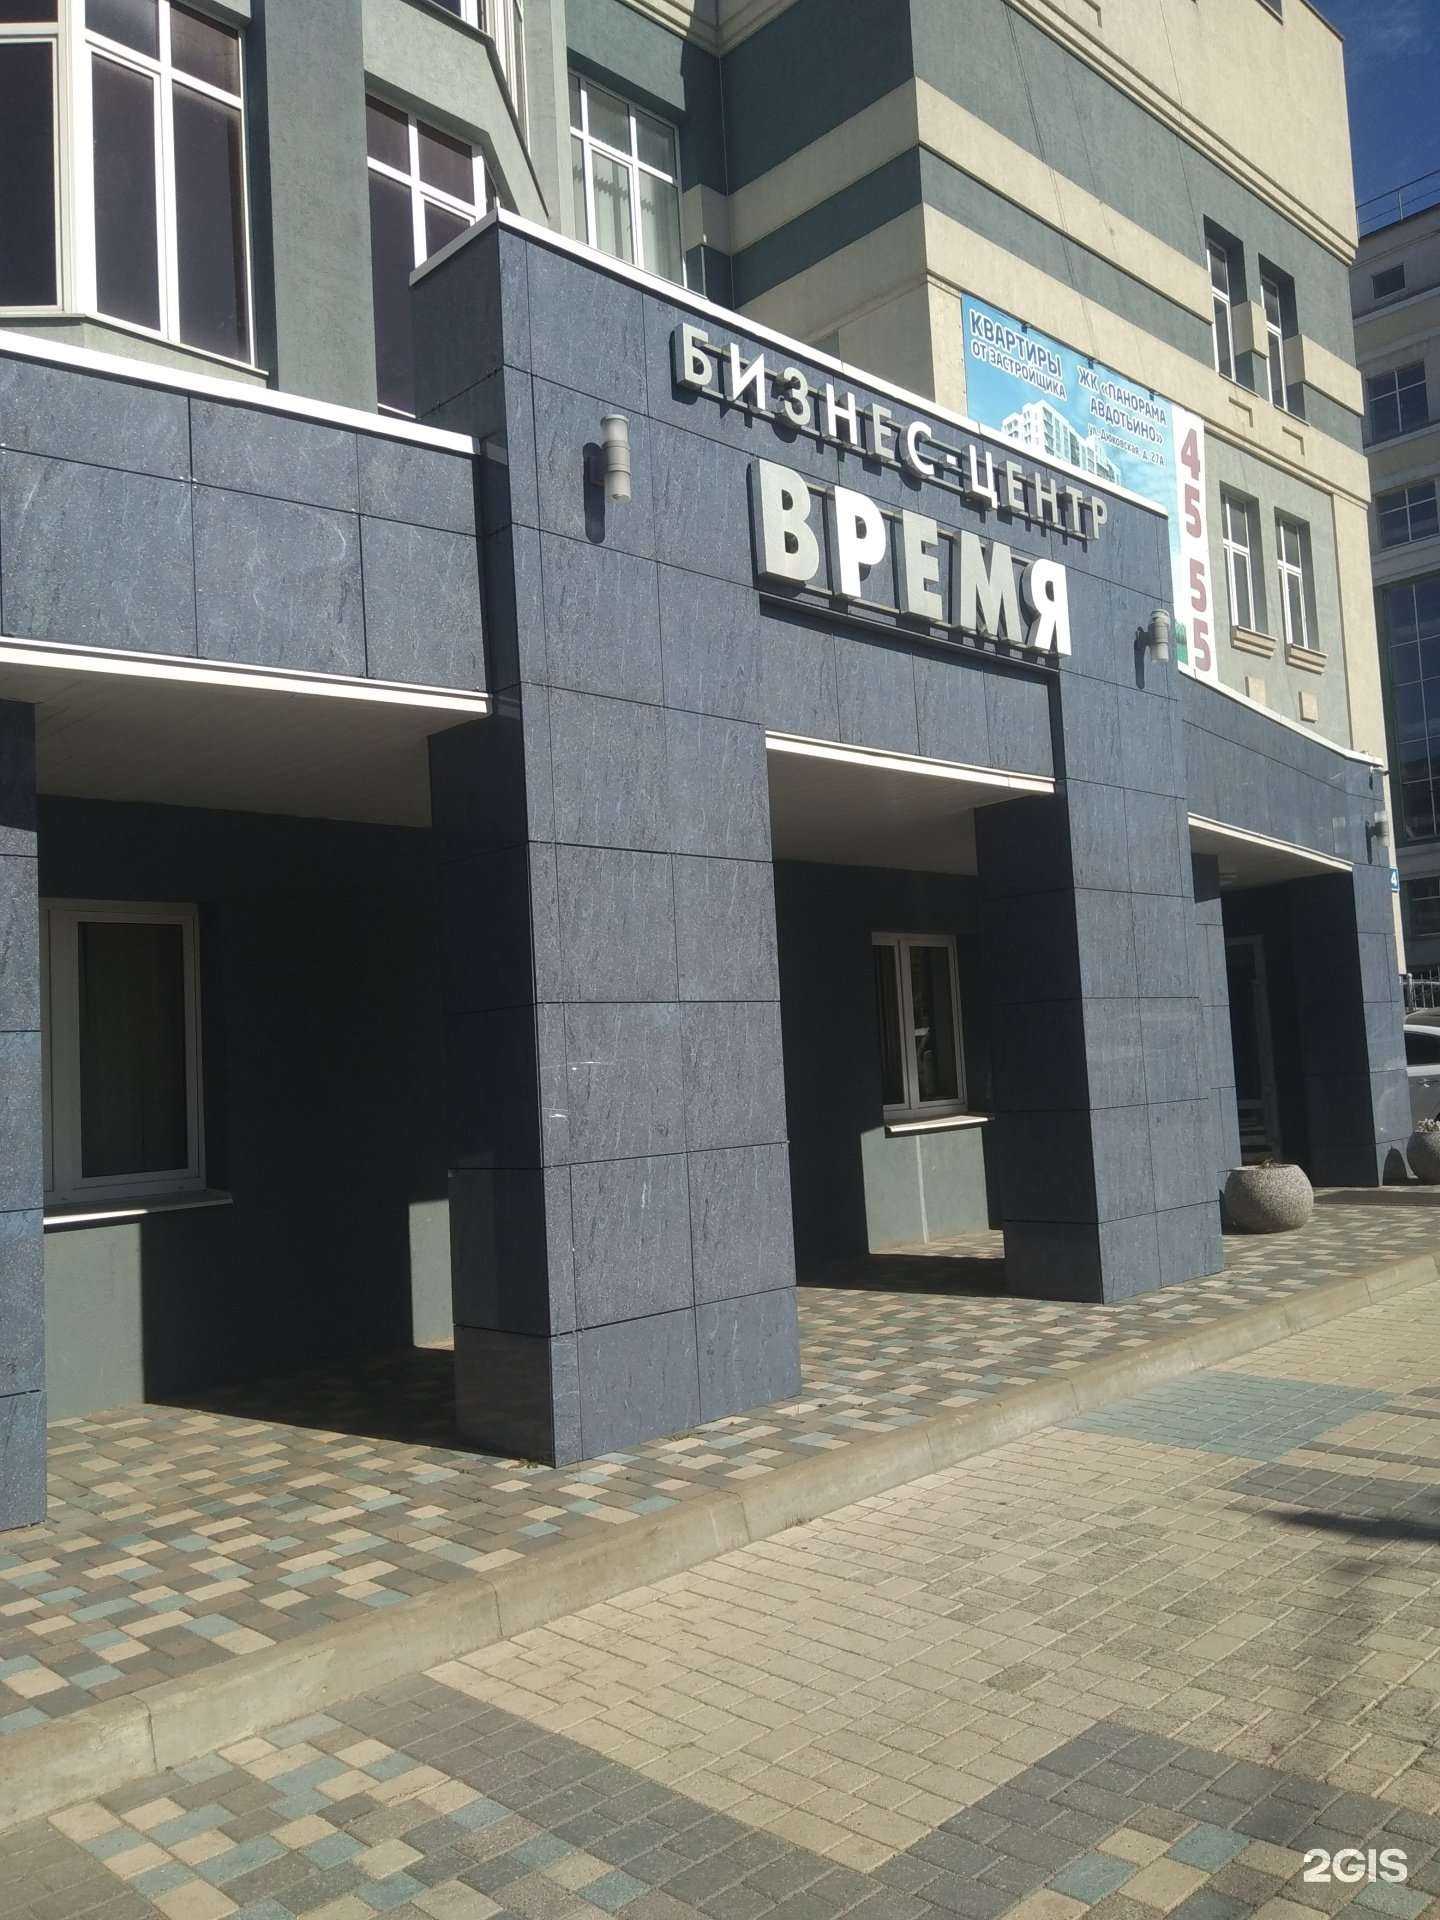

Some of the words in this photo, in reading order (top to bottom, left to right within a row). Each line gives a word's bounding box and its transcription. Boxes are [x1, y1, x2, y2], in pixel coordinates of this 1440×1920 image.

[970, 310, 1061, 378] КВАРТИРЫ
[972, 341, 986, 360] ОТ
[990, 349, 1066, 400] ЗАСТРОЙЩИКА
[1079, 367, 1098, 391] ЖК
[1101, 383, 1167, 425] «ПАНОРАМА
[1090, 398, 1163, 444] АВДОТЬИНО»
[677, 323, 1107, 540] БИЗНЕС-ЦЕНТР
[756, 459, 1071, 657] ВРЕМЯ
